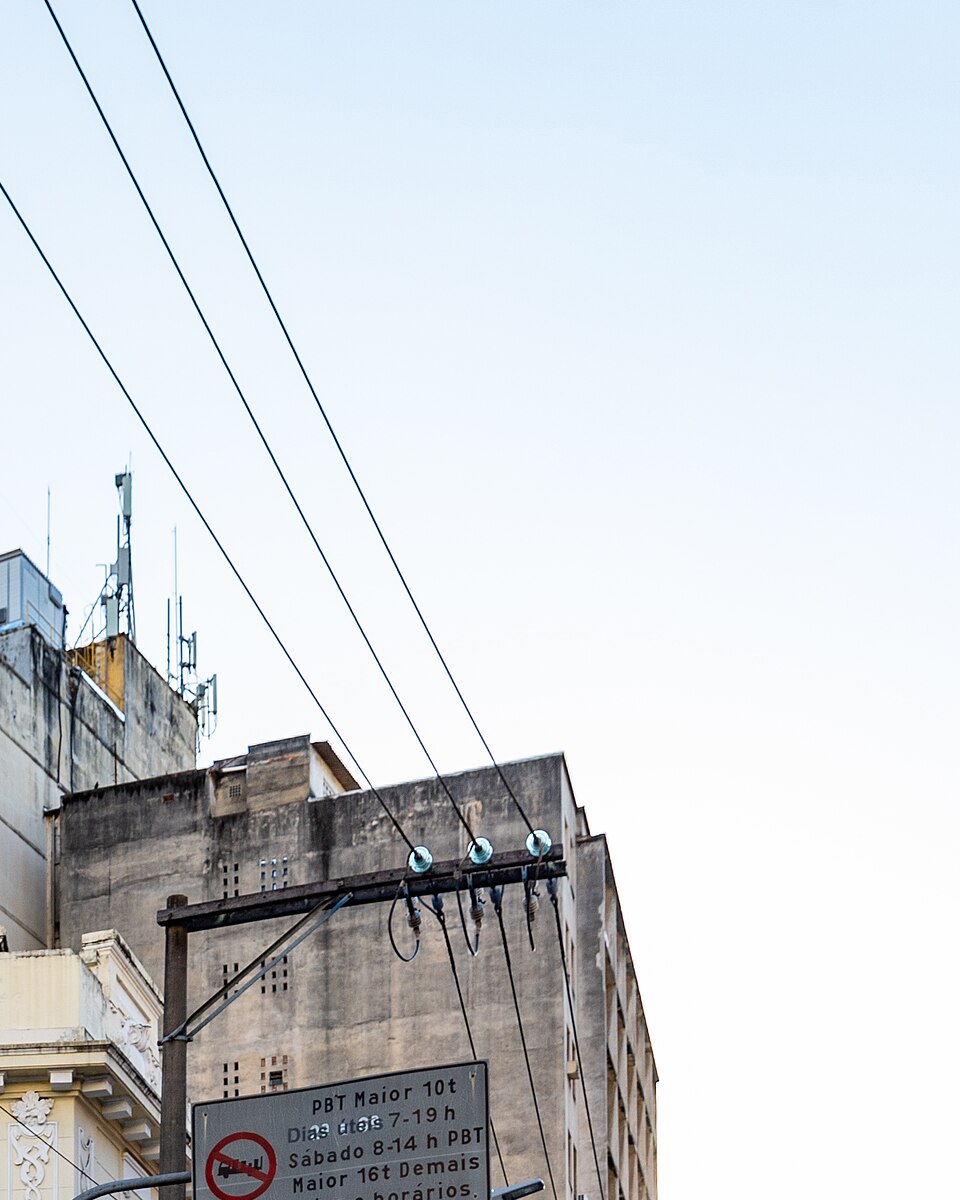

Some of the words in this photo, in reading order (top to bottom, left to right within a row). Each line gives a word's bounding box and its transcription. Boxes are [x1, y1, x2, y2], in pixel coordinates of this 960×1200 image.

[312, 1094, 346, 1116] PBT
[354, 1088, 413, 1109] Maior
[423, 1078, 457, 1098] 10t
[288, 1124, 329, 1144] Dias
[337, 1116, 384, 1136] úteis
[389, 1107, 437, 1128] 7-19
[445, 1106, 456, 1121] h
[289, 1145, 364, 1168] Sábado
[373, 1136, 418, 1157] 8-14
[427, 1133, 438, 1149] h
[448, 1127, 484, 1147] PBT
[293, 1172, 348, 1194] Maior
[358, 1163, 391, 1185] 16t
[399, 1154, 481, 1179] Demais
